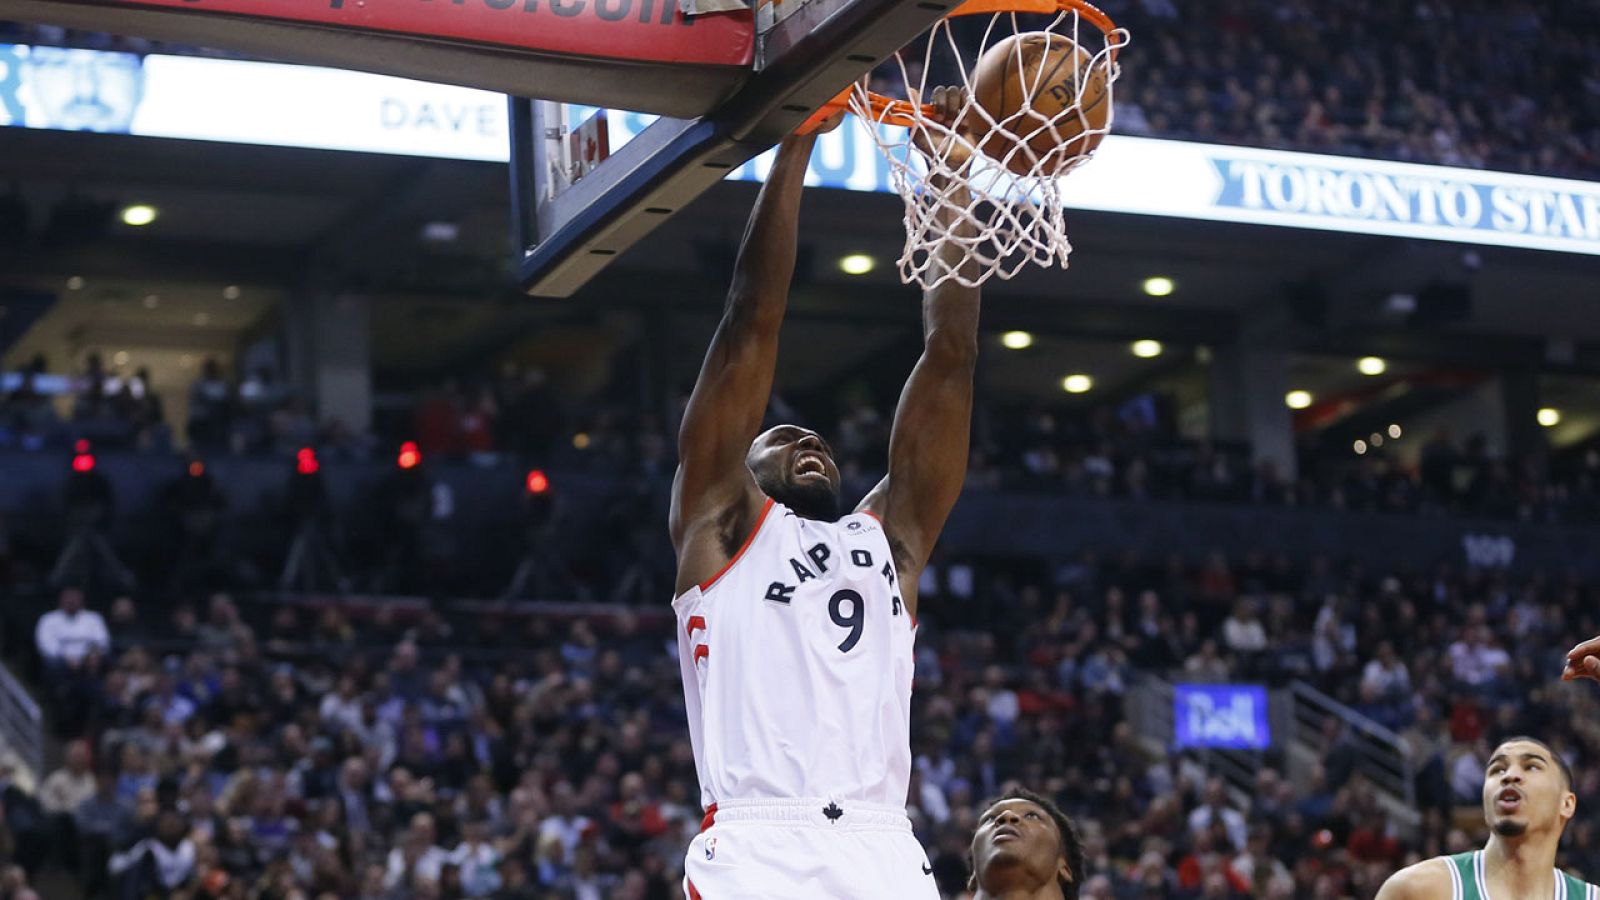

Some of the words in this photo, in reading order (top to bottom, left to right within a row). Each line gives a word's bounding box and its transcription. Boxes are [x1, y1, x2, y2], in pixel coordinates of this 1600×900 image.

[380, 97, 498, 136] DAVE
[1229, 160, 1481, 229] TORONTO
[827, 588, 866, 654] 9
